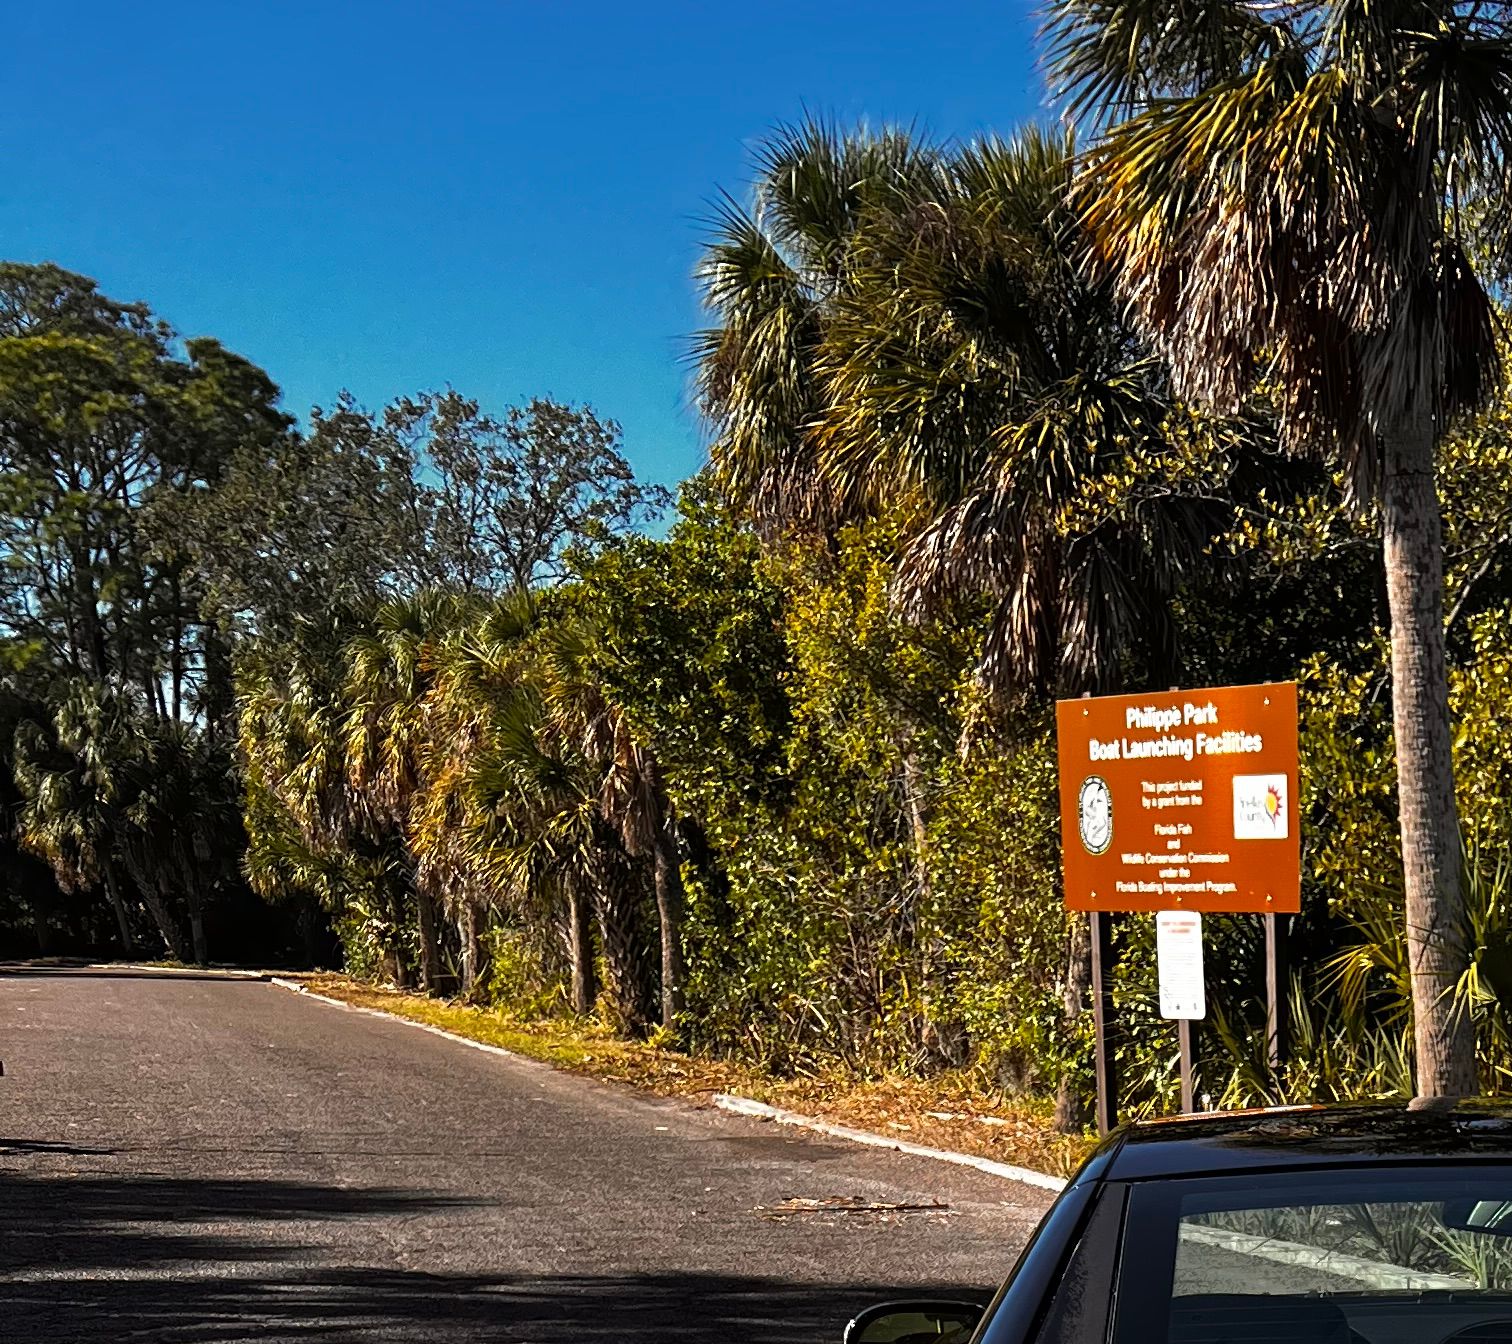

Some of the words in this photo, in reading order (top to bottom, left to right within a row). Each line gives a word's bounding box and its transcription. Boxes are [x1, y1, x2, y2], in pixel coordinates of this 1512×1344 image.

[1126, 705, 1181, 732] Philippe
[1183, 701, 1218, 725] Park
[1089, 738, 1120, 761] Boat
[1121, 734, 1194, 761] Launching
[1195, 730, 1262, 755] Facilities
[1141, 781, 1156, 793] This
[1156, 781, 1179, 795] project
[1179, 780, 1203, 791] funded
[1141, 796, 1151, 809] by
[1152, 798, 1157, 807] a
[1157, 797, 1175, 809] grant
[1175, 795, 1190, 806] from
[1190, 794, 1203, 805] the
[1154, 824, 1177, 836] Florida
[1177, 823, 1193, 835] Fish
[1167, 838, 1181, 849] and
[1145, 852, 1188, 864] Conservation
[1188, 852, 1230, 864] Commission
[1158, 867, 1179, 878] under
[1179, 867, 1191, 878] the
[1115, 881, 1138, 892] Florida
